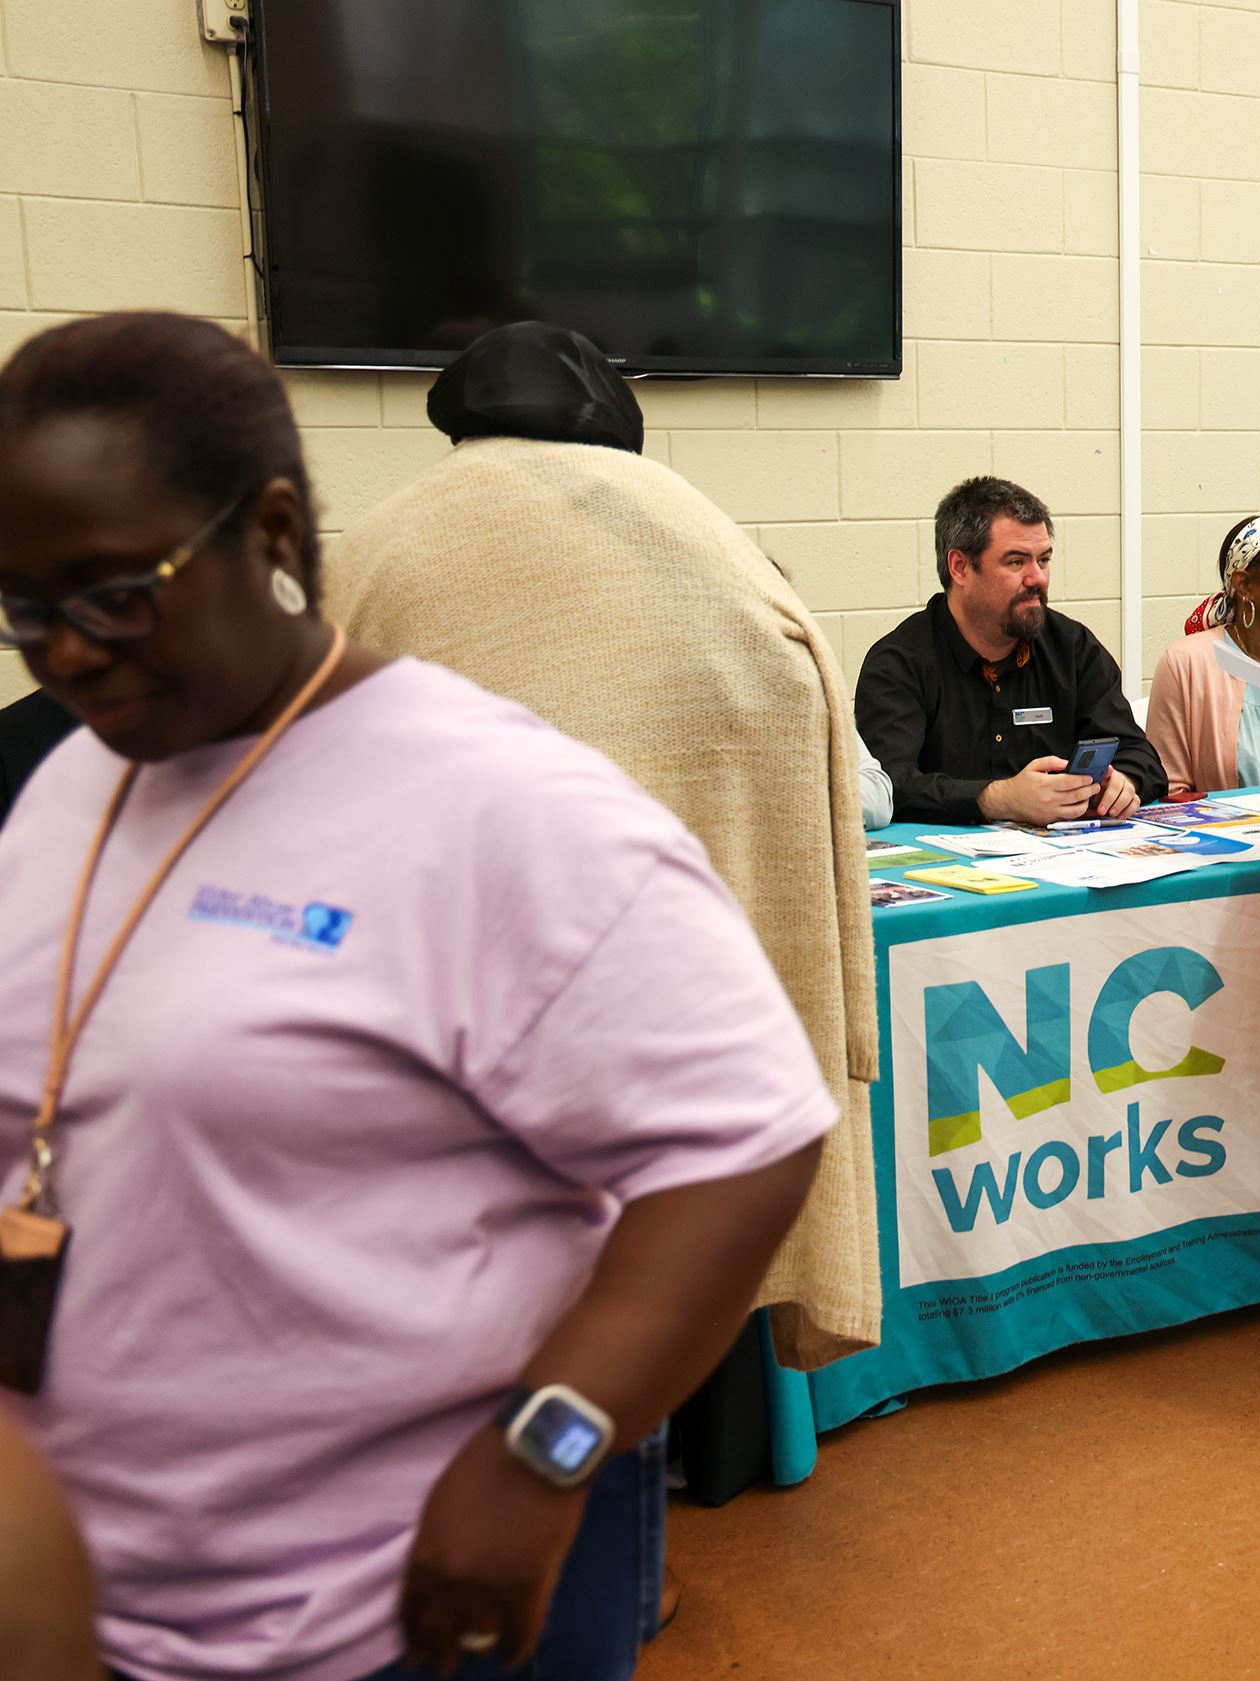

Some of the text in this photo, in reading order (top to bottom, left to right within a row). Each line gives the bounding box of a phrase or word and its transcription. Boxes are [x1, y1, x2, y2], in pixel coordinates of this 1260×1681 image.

[923, 946, 1225, 1158] NC
[931, 1101, 1227, 1233] works
[918, 1309, 950, 1321] totaling
[975, 1303, 1002, 1314] million
[1026, 1280, 1055, 1296] financed
[1056, 1273, 1073, 1285] from
[1075, 1266, 1149, 1281] non-governmental
[919, 1300, 936, 1309] This
[939, 1296, 967, 1306] WIOA
[970, 1294, 988, 1304] Title
[995, 1283, 1021, 1300] program
[1021, 1268, 1056, 1289] publication
[1058, 1265, 1064, 1274] is
[1065, 1261, 1095, 1272] funded
[1097, 1261, 1107, 1270] by
[1109, 1259, 1123, 1267] the
[1125, 1247, 1167, 1265] Employment
[1168, 1243, 1181, 1254] and
[1182, 1235, 1206, 1249] Training
